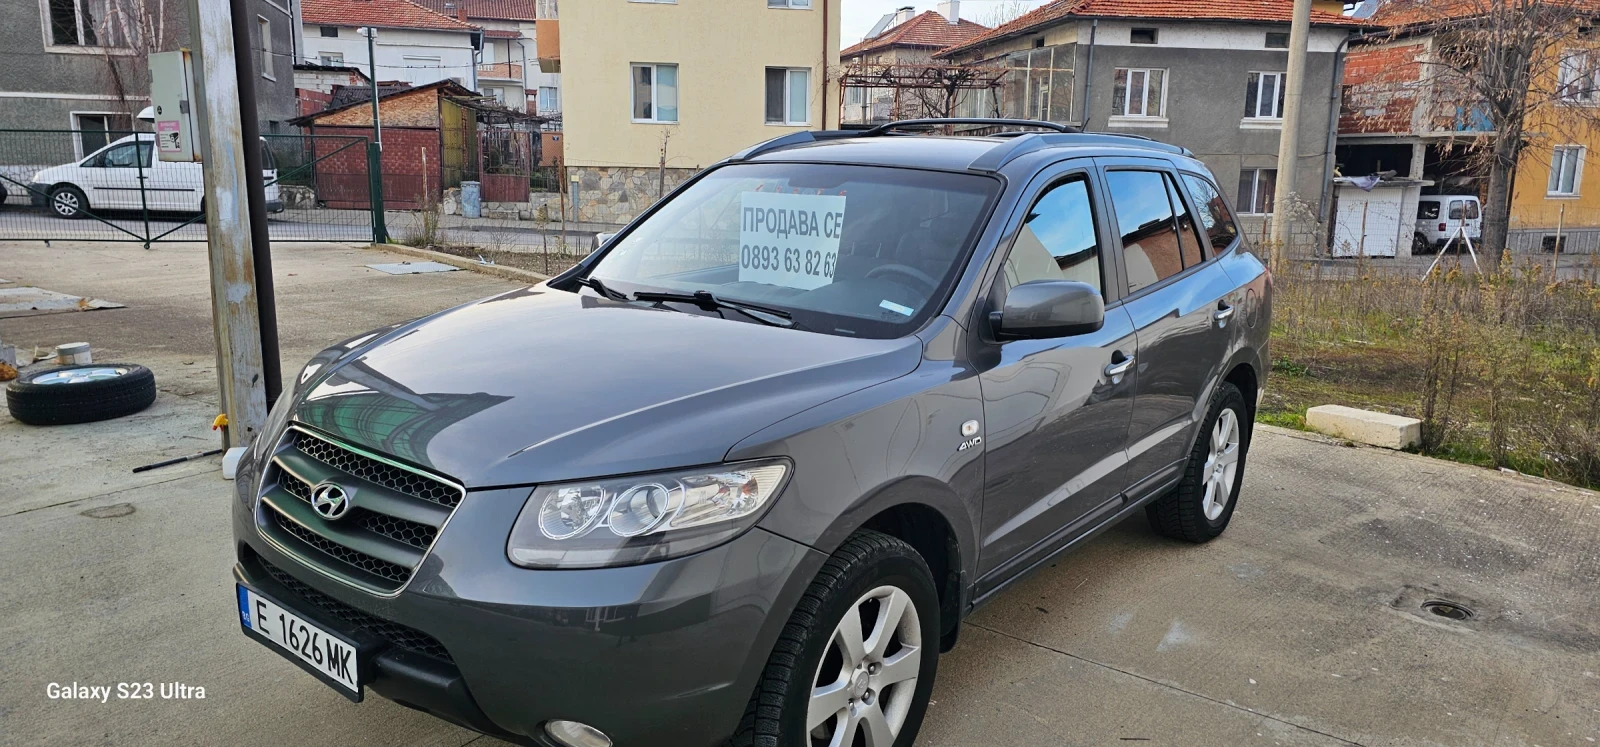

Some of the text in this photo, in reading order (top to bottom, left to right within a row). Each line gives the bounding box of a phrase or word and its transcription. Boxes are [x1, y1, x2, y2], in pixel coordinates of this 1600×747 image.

[743, 207, 843, 239] ПРОДАВА СЕ
[741, 245, 836, 278] 0893 63 82 63
[958, 436, 981, 450] 4WD
[279, 614, 323, 665] 1626
